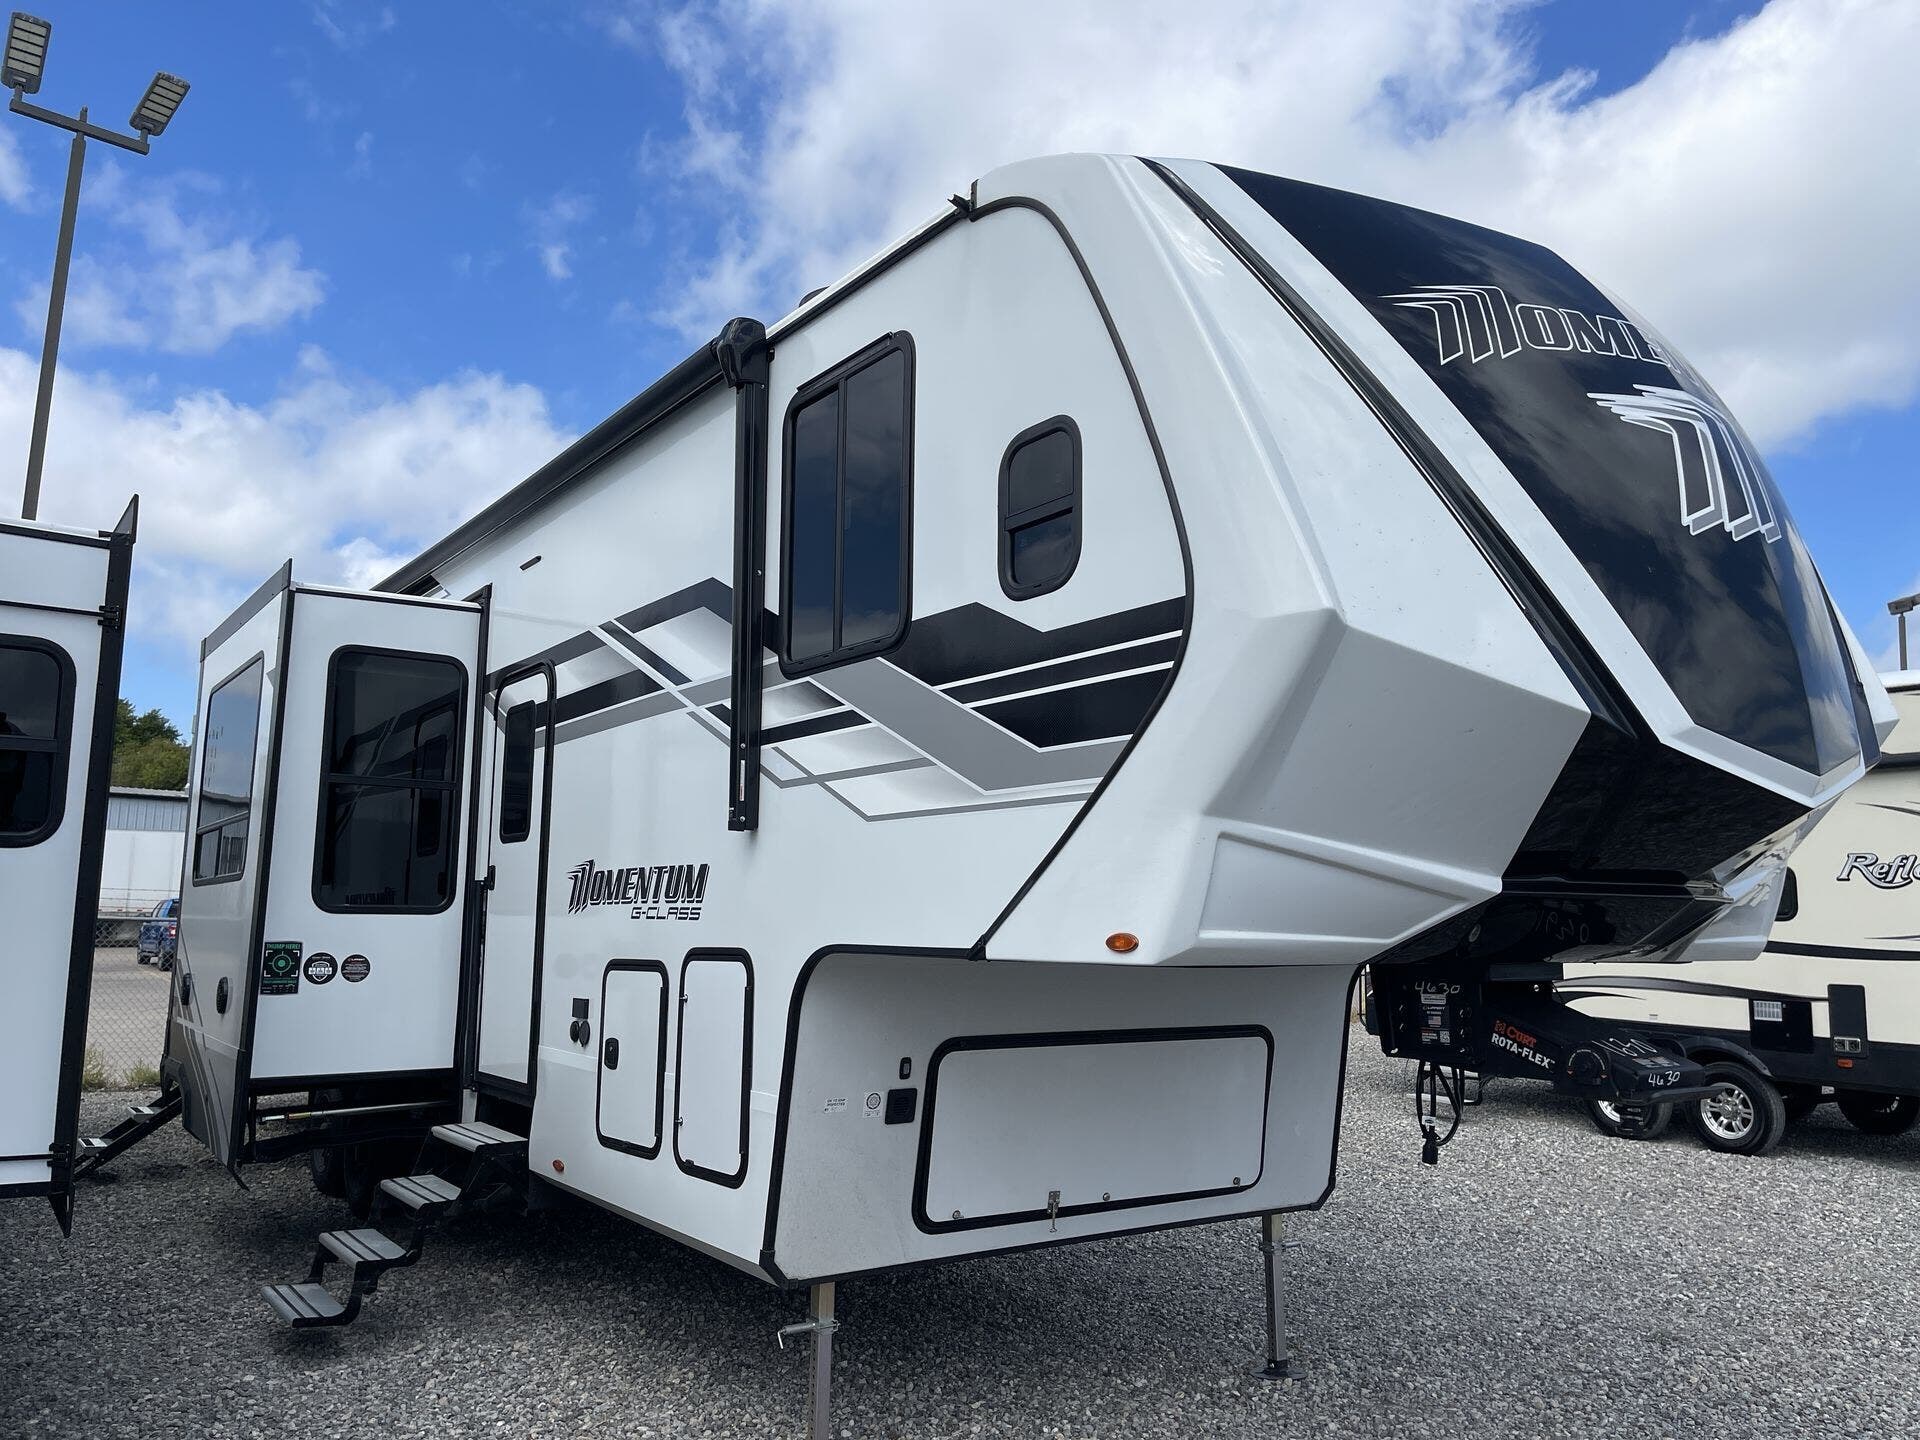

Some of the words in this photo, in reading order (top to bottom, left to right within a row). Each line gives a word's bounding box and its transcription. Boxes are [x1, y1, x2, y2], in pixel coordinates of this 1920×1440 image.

[566, 859, 710, 914] MOMENTUM
[631, 907, 702, 921] G-CLASS
[1415, 980, 1460, 995] 4630
[1648, 1070, 1681, 1087] 4630
